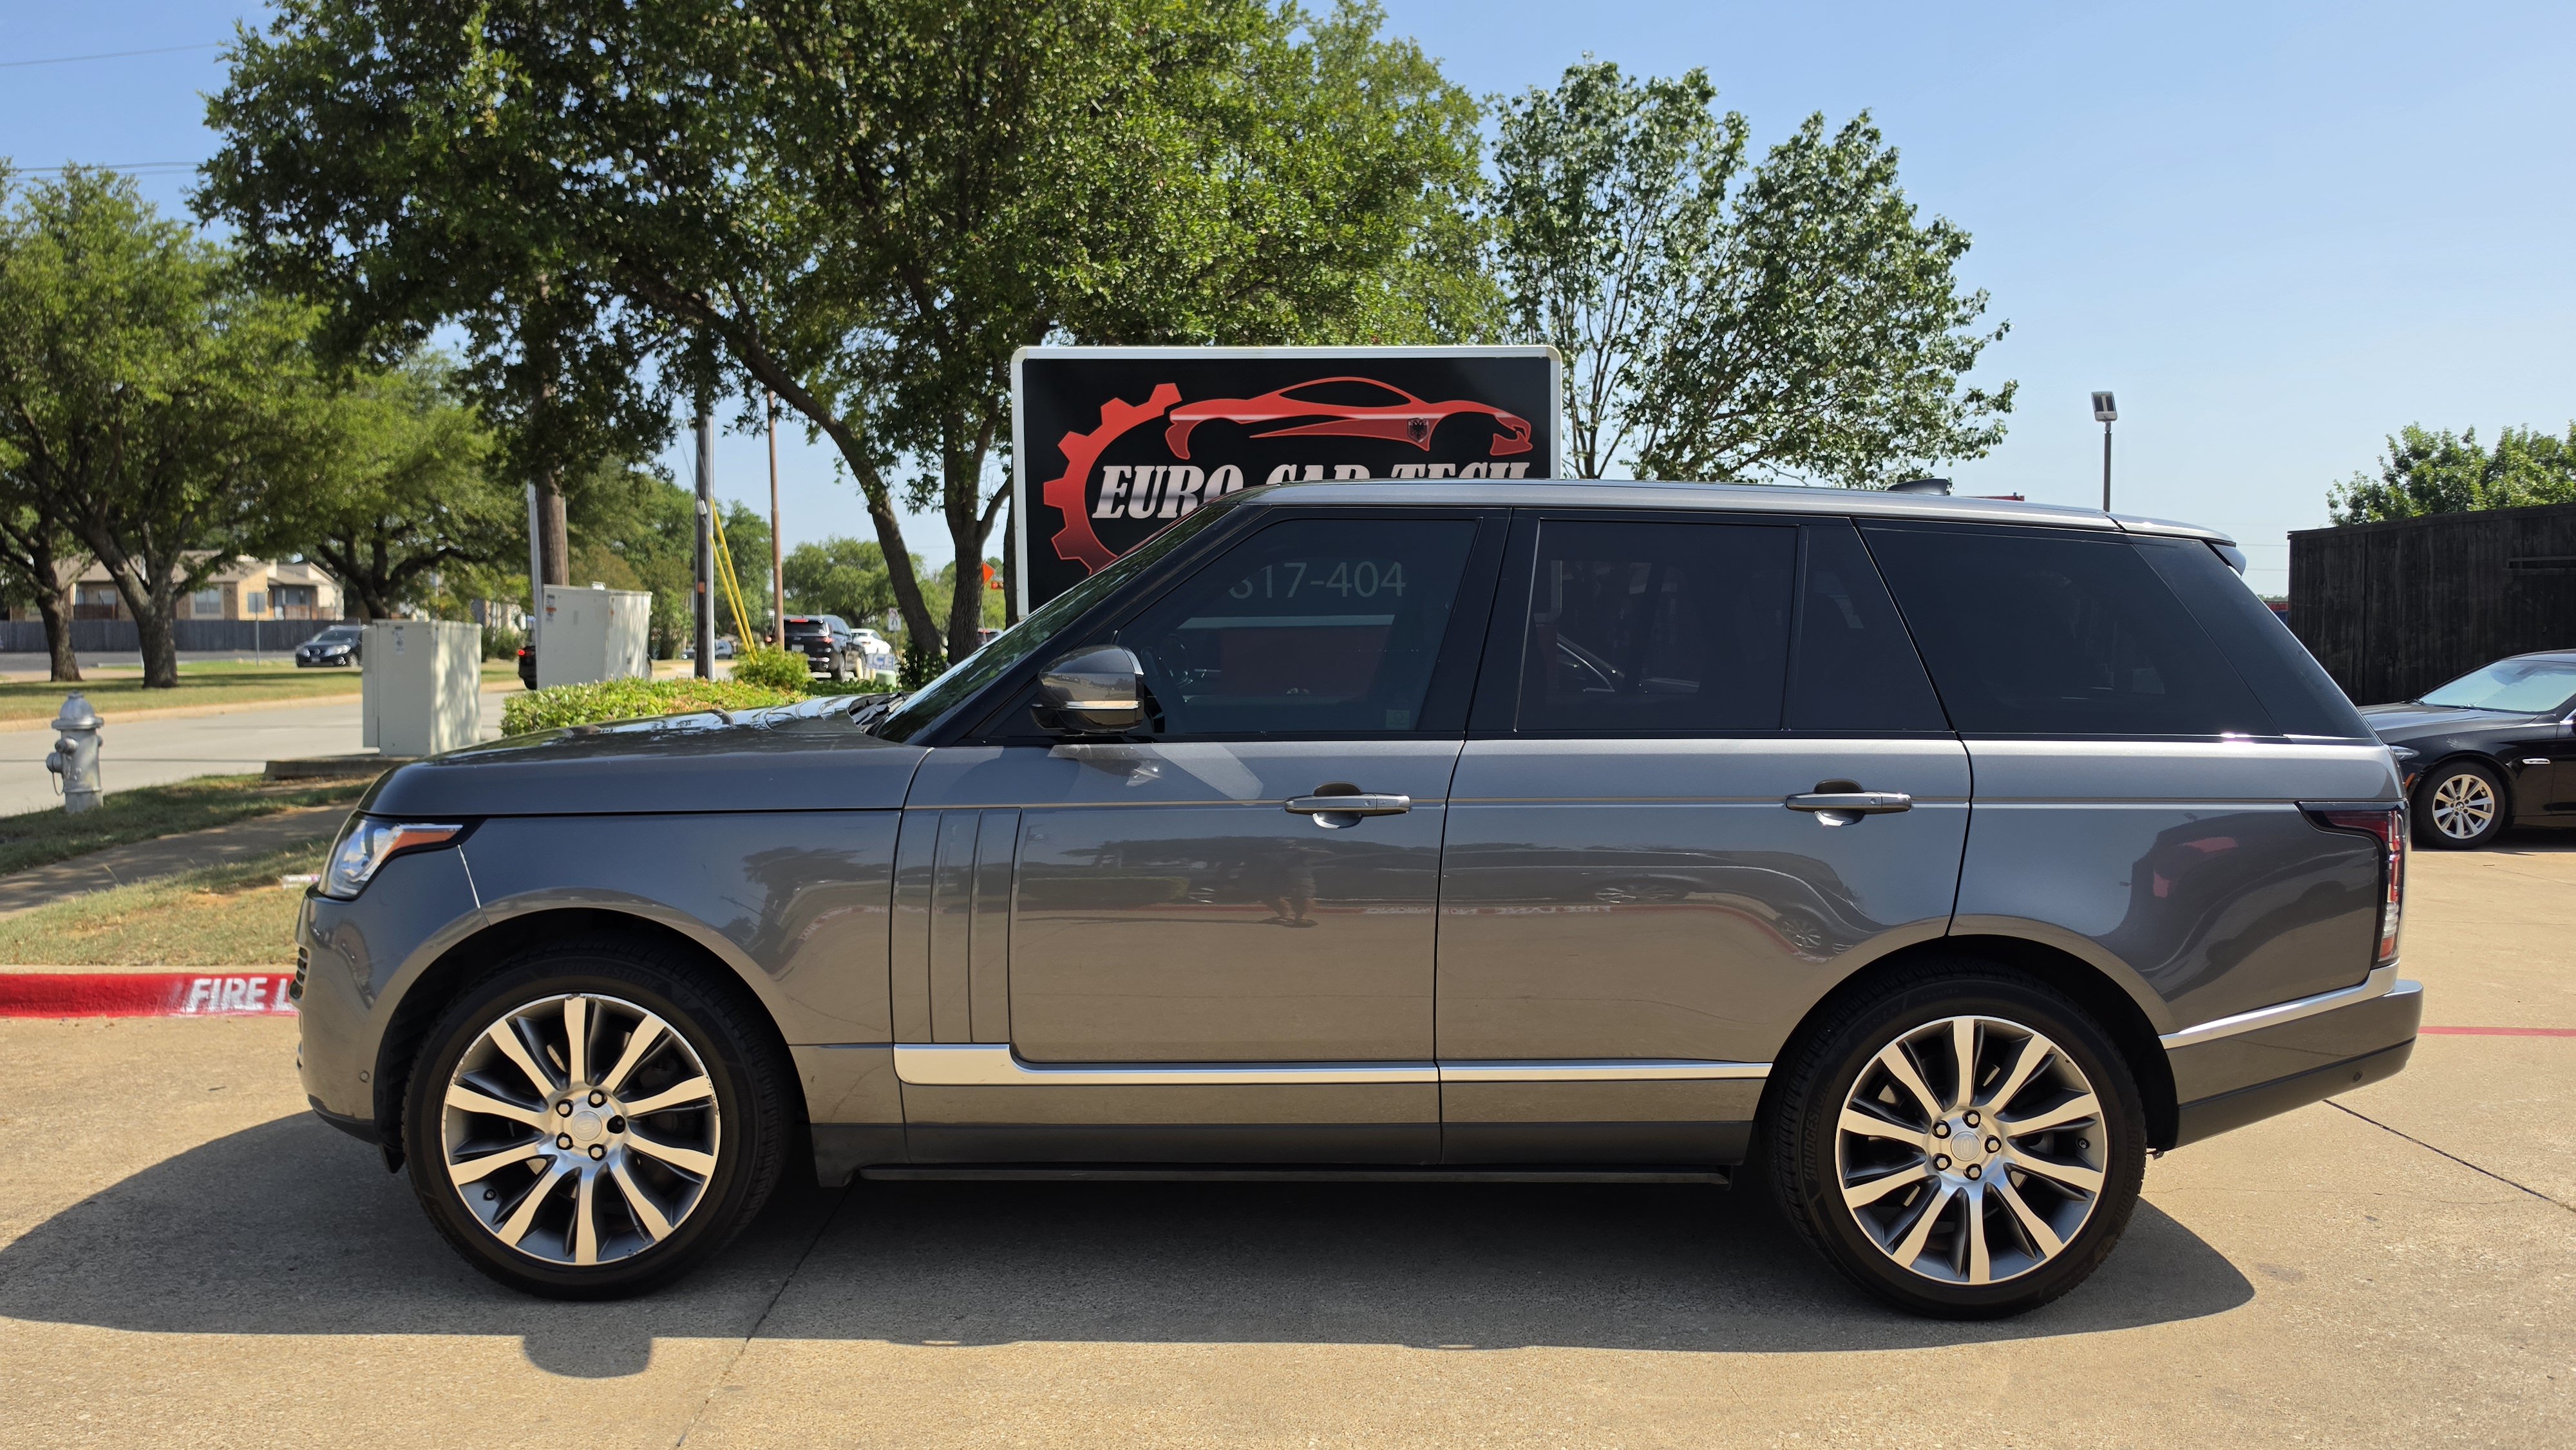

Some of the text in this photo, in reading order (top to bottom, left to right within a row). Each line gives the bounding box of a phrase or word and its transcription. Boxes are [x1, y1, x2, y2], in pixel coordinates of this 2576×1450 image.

[1092, 464, 1244, 519] EURO
[184, 977, 267, 1012] FIRE
[1803, 1079, 1833, 1181] BRIDGESTO
